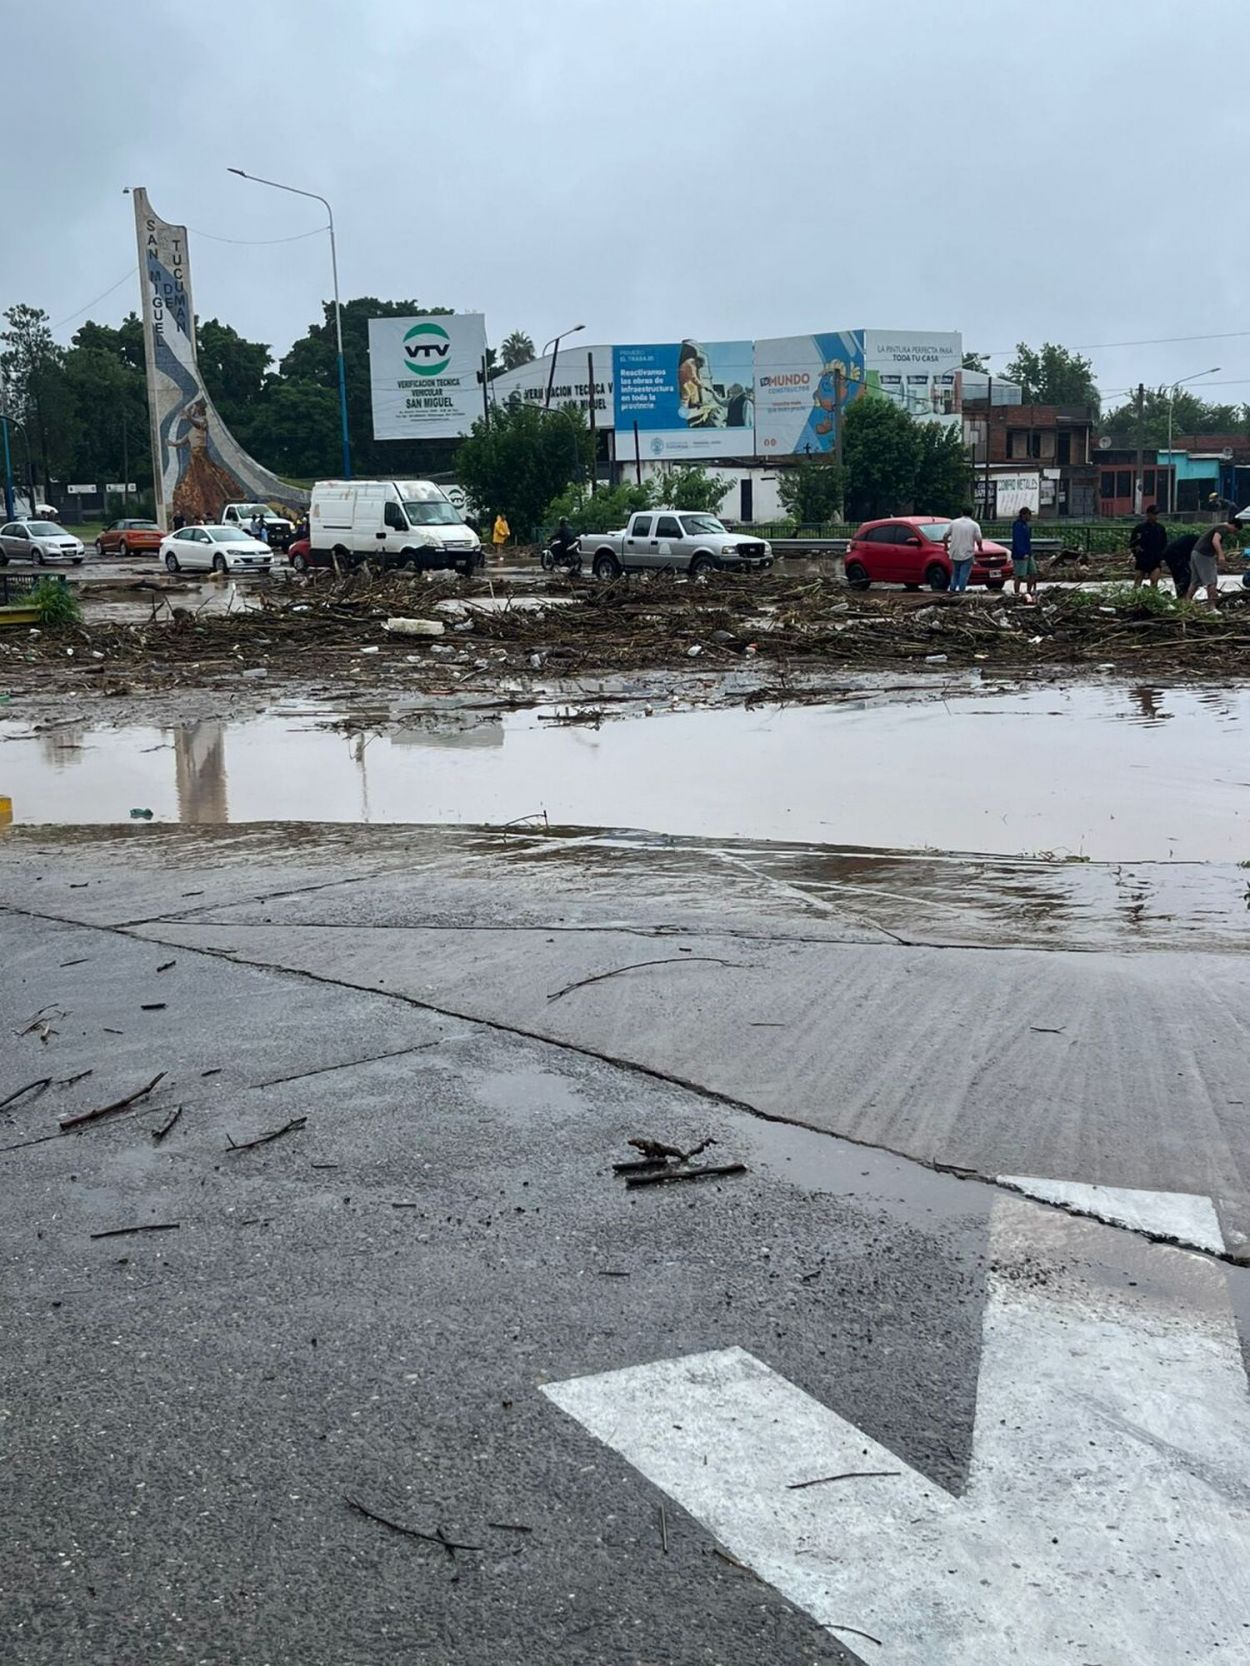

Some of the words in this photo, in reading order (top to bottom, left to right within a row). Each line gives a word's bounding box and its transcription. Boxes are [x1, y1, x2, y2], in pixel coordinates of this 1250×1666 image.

[146, 219, 158, 260] SAN
[172, 240, 185, 332] TUCUMAN
[150, 271, 164, 347] MIGUEL
[404, 343, 450, 358] VTV
[922, 354, 939, 362] CASA
[655, 376, 664, 384] de
[768, 373, 810, 387] MUNDO
[574, 383, 605, 396] TECCA
[406, 398, 421, 409] SAN
[424, 397, 453, 408] MIGUEL
